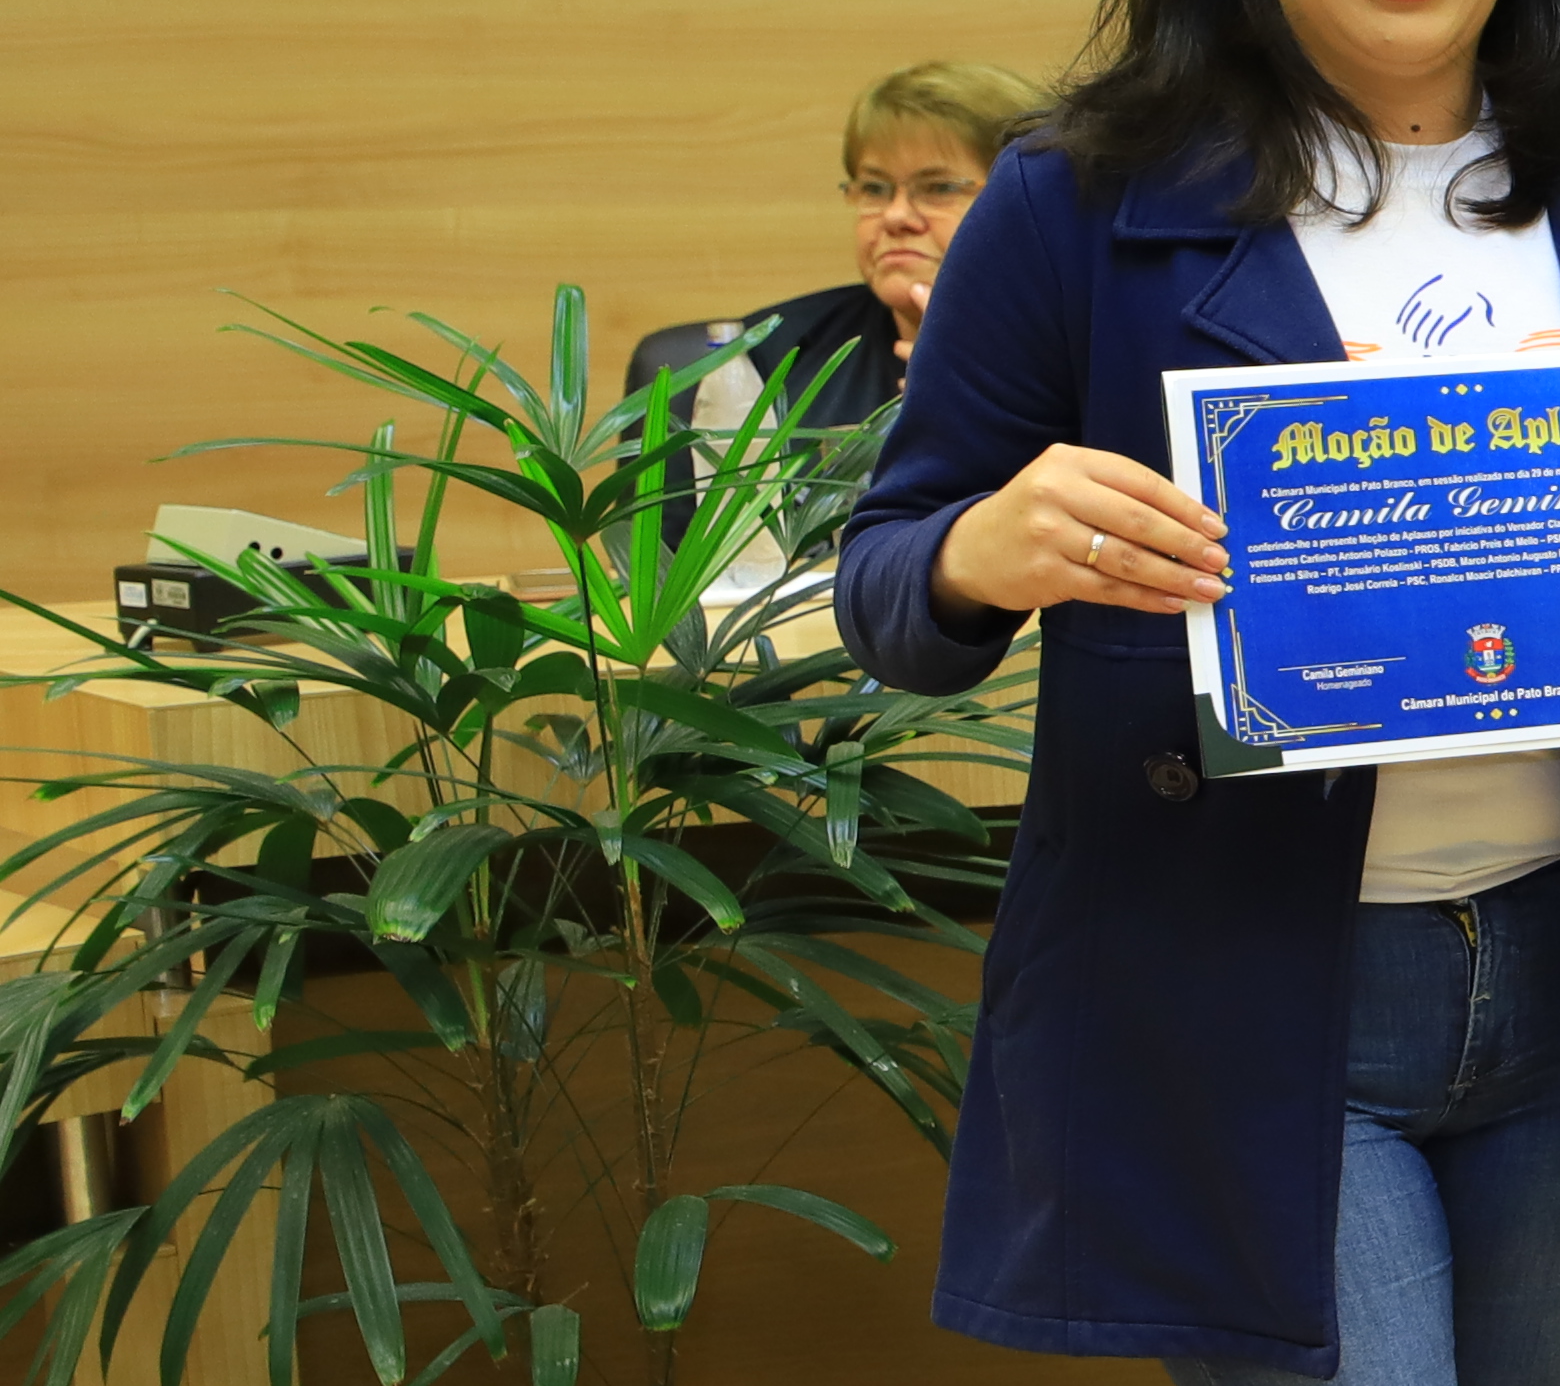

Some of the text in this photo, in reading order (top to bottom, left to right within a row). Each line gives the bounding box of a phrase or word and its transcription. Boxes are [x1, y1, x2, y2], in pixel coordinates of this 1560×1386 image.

[1270, 415, 1416, 471] Moção
[1426, 415, 1475, 454] de
[1268, 487, 1304, 497] Câmara
[1304, 482, 1348, 495] Municipal
[1360, 480, 1382, 490] Pato
[1381, 478, 1416, 489] Branco,
[1431, 473, 1464, 485] sessão
[1463, 471, 1503, 483] realizada
[1515, 469, 1531, 479] dia
[1272, 490, 1431, 531] Camila
[1301, 663, 1384, 681] Camila Geminiano
[1400, 697, 1444, 711] Câmara
[1444, 689, 1499, 706] Municipal
[1499, 688, 1515, 701] de
[1515, 687, 1542, 699] Pato
